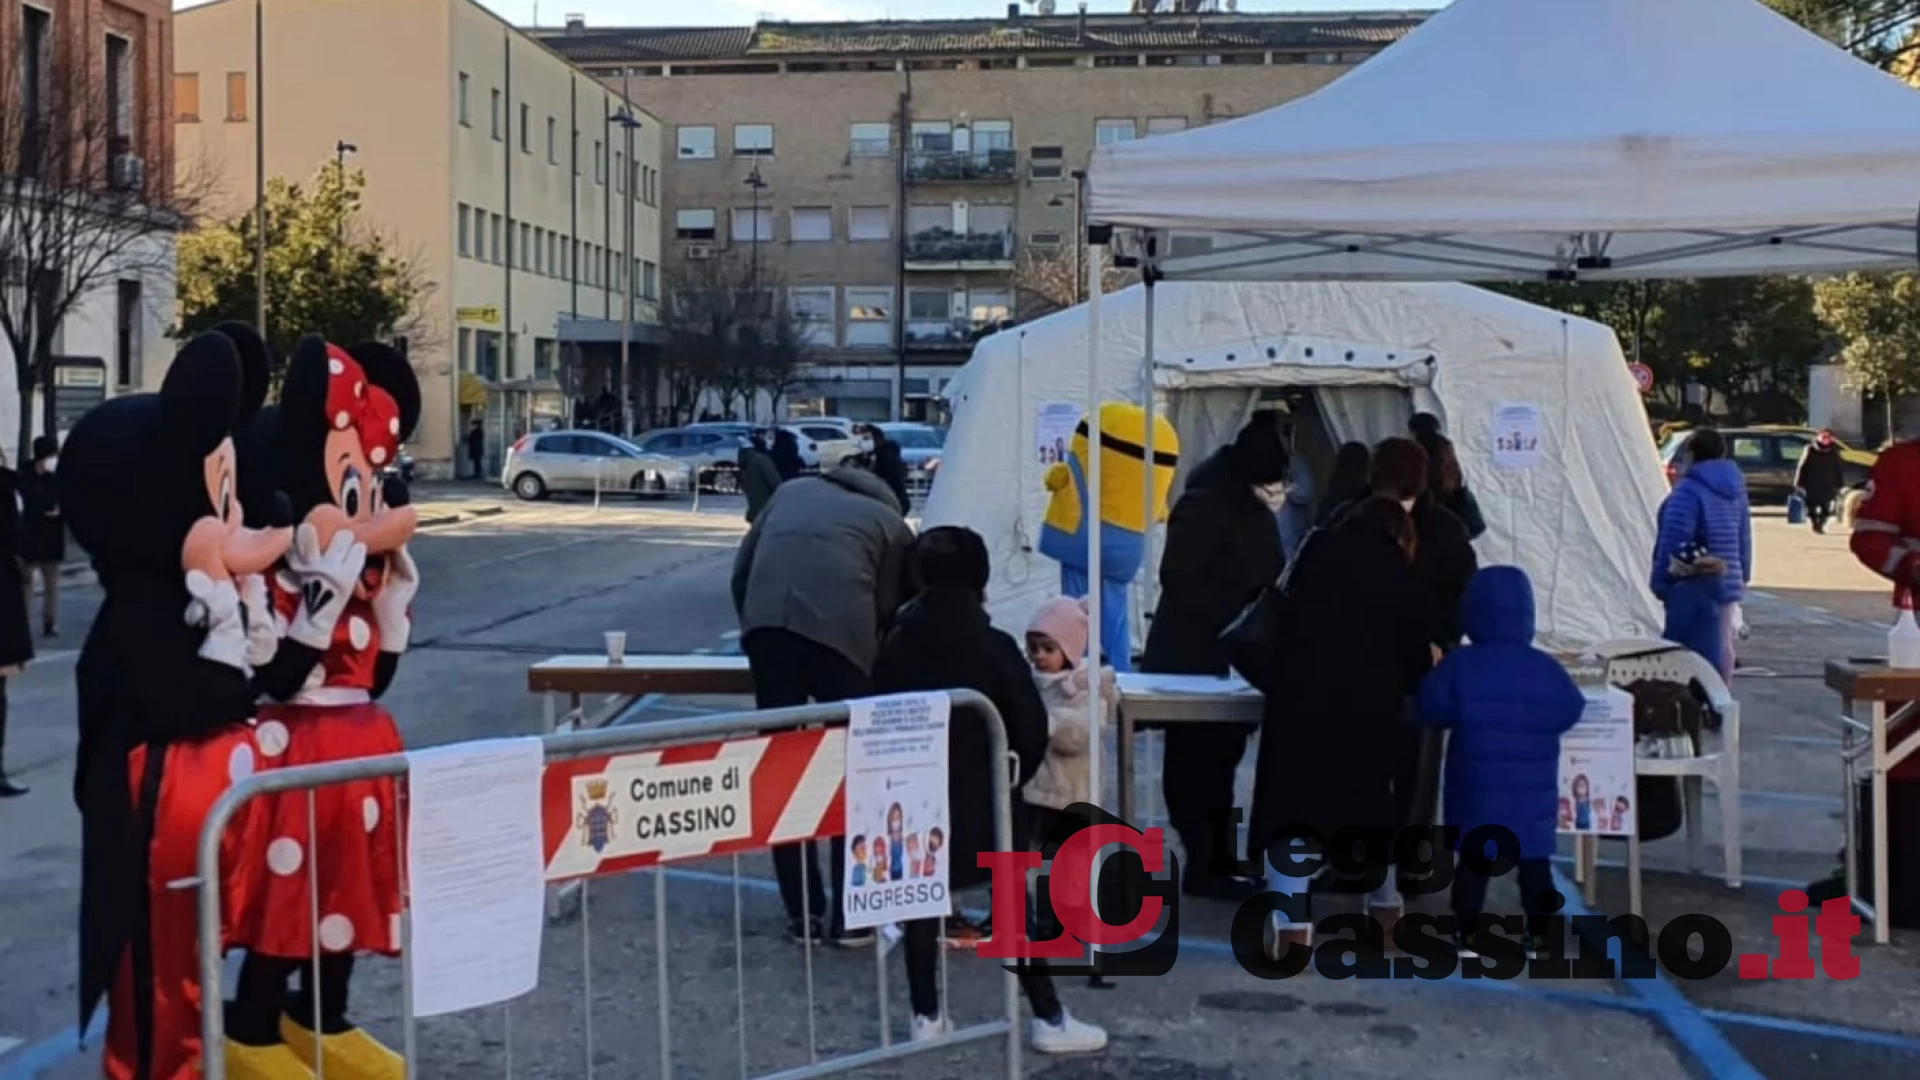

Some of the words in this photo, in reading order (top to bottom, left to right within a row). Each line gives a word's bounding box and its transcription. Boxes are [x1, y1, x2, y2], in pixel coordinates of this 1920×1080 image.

[630, 773, 713, 802] Comune
[720, 766, 740, 791] di
[636, 804, 737, 840] CASSINO
[846, 882, 945, 914] INGRESSO
